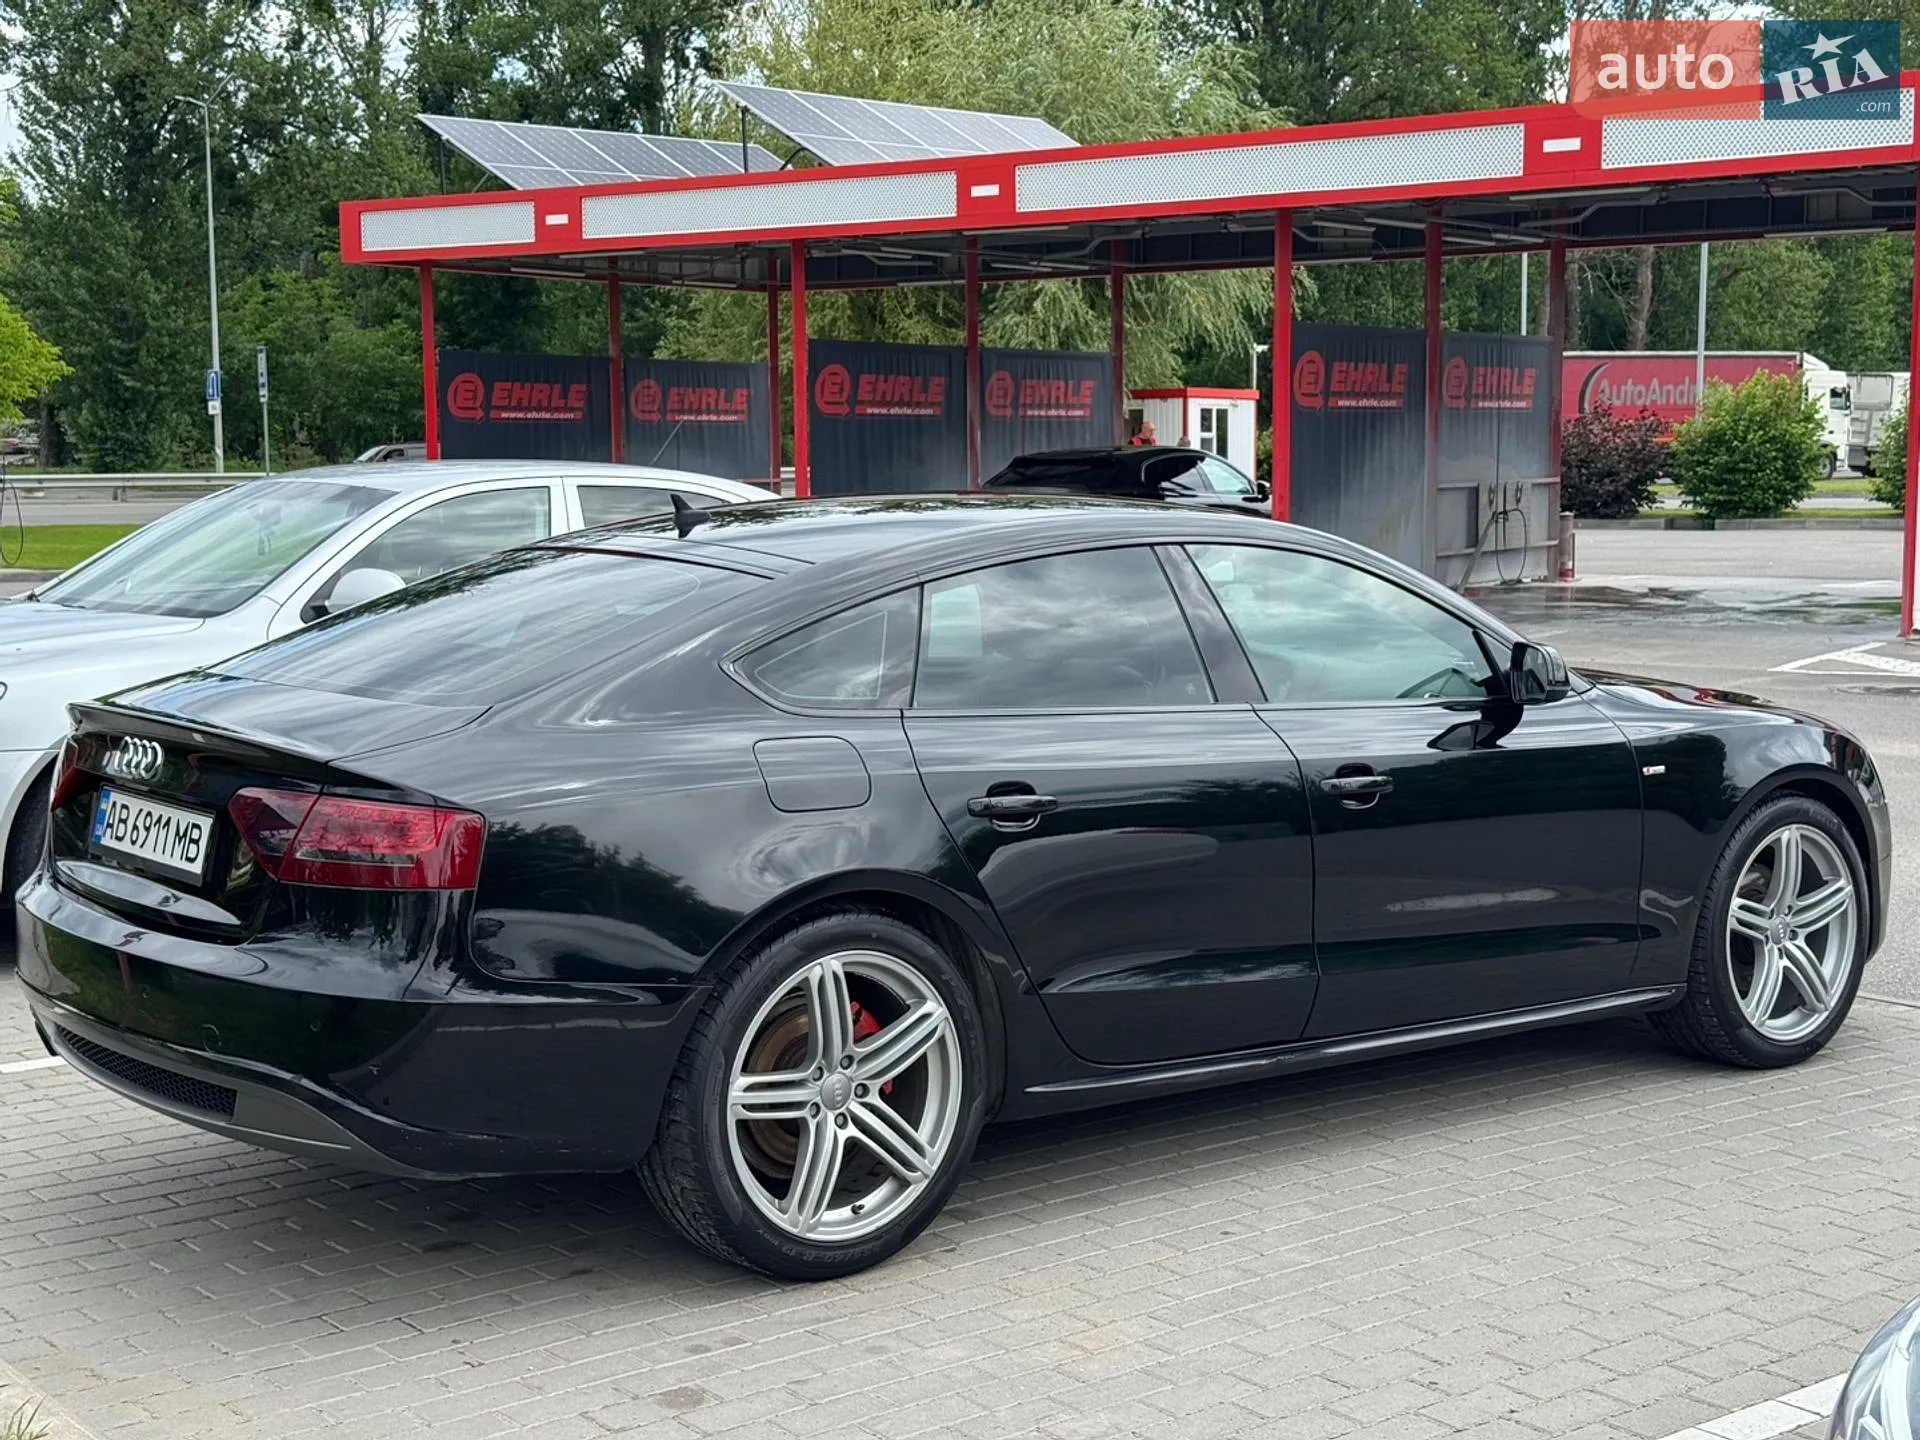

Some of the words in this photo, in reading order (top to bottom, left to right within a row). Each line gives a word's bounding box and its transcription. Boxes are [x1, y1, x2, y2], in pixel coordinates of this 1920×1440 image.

[857, 374, 945, 402] EHRLE
[1331, 362, 1408, 393] EHRLE
[1472, 367, 1536, 395] EHRLE
[492, 382, 587, 407] EHRLE
[1020, 379, 1094, 404] EHRLE
[501, 410, 574, 419] www.ehrle.com
[866, 406, 933, 415] www.ehrle.com
